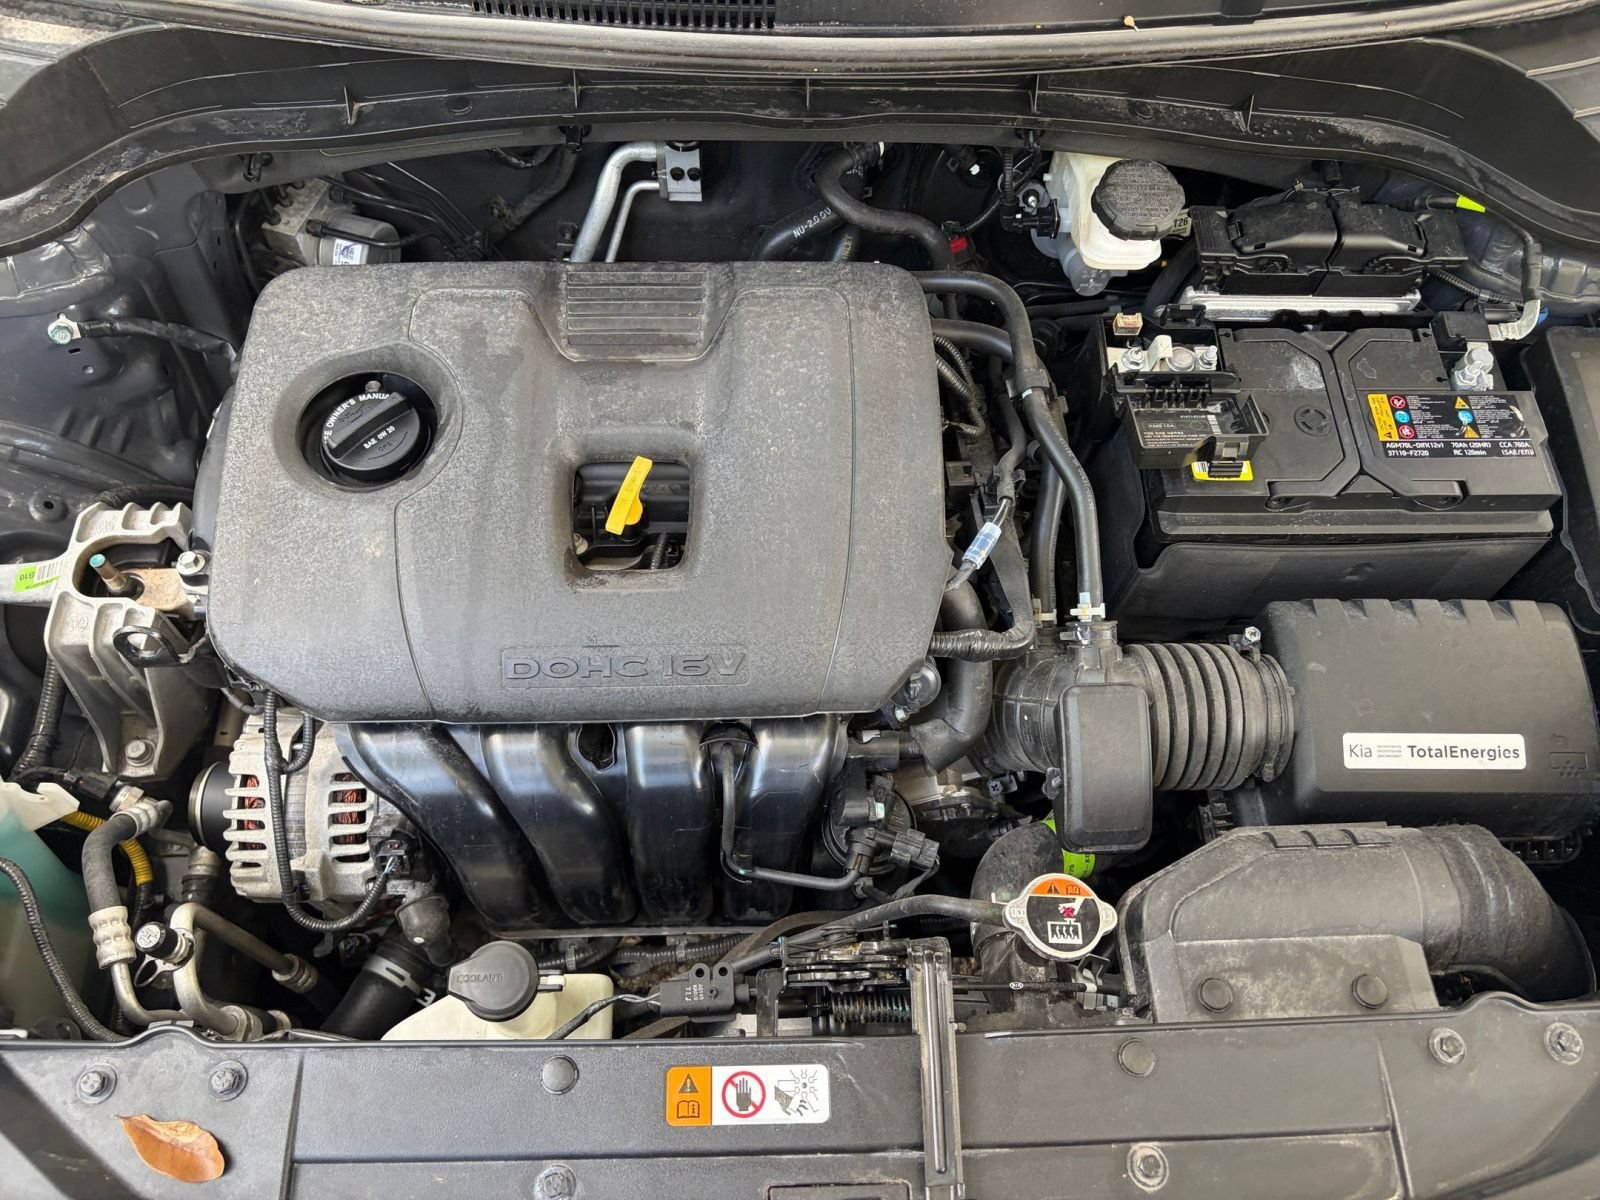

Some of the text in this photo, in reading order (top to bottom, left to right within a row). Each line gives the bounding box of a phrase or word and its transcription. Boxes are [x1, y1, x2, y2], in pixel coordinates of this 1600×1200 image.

[820, 206, 832, 219] OU
[326, 398, 356, 428] OWNER'S
[358, 392, 390, 402] MANU
[363, 437, 378, 449] SAE
[386, 425, 396, 434] 20
[505, 653, 745, 680] DOHC 16V
[1349, 743, 1373, 758] Kia
[1407, 745, 1520, 761] TotalEnergies
[457, 973, 503, 985] COOLANT
